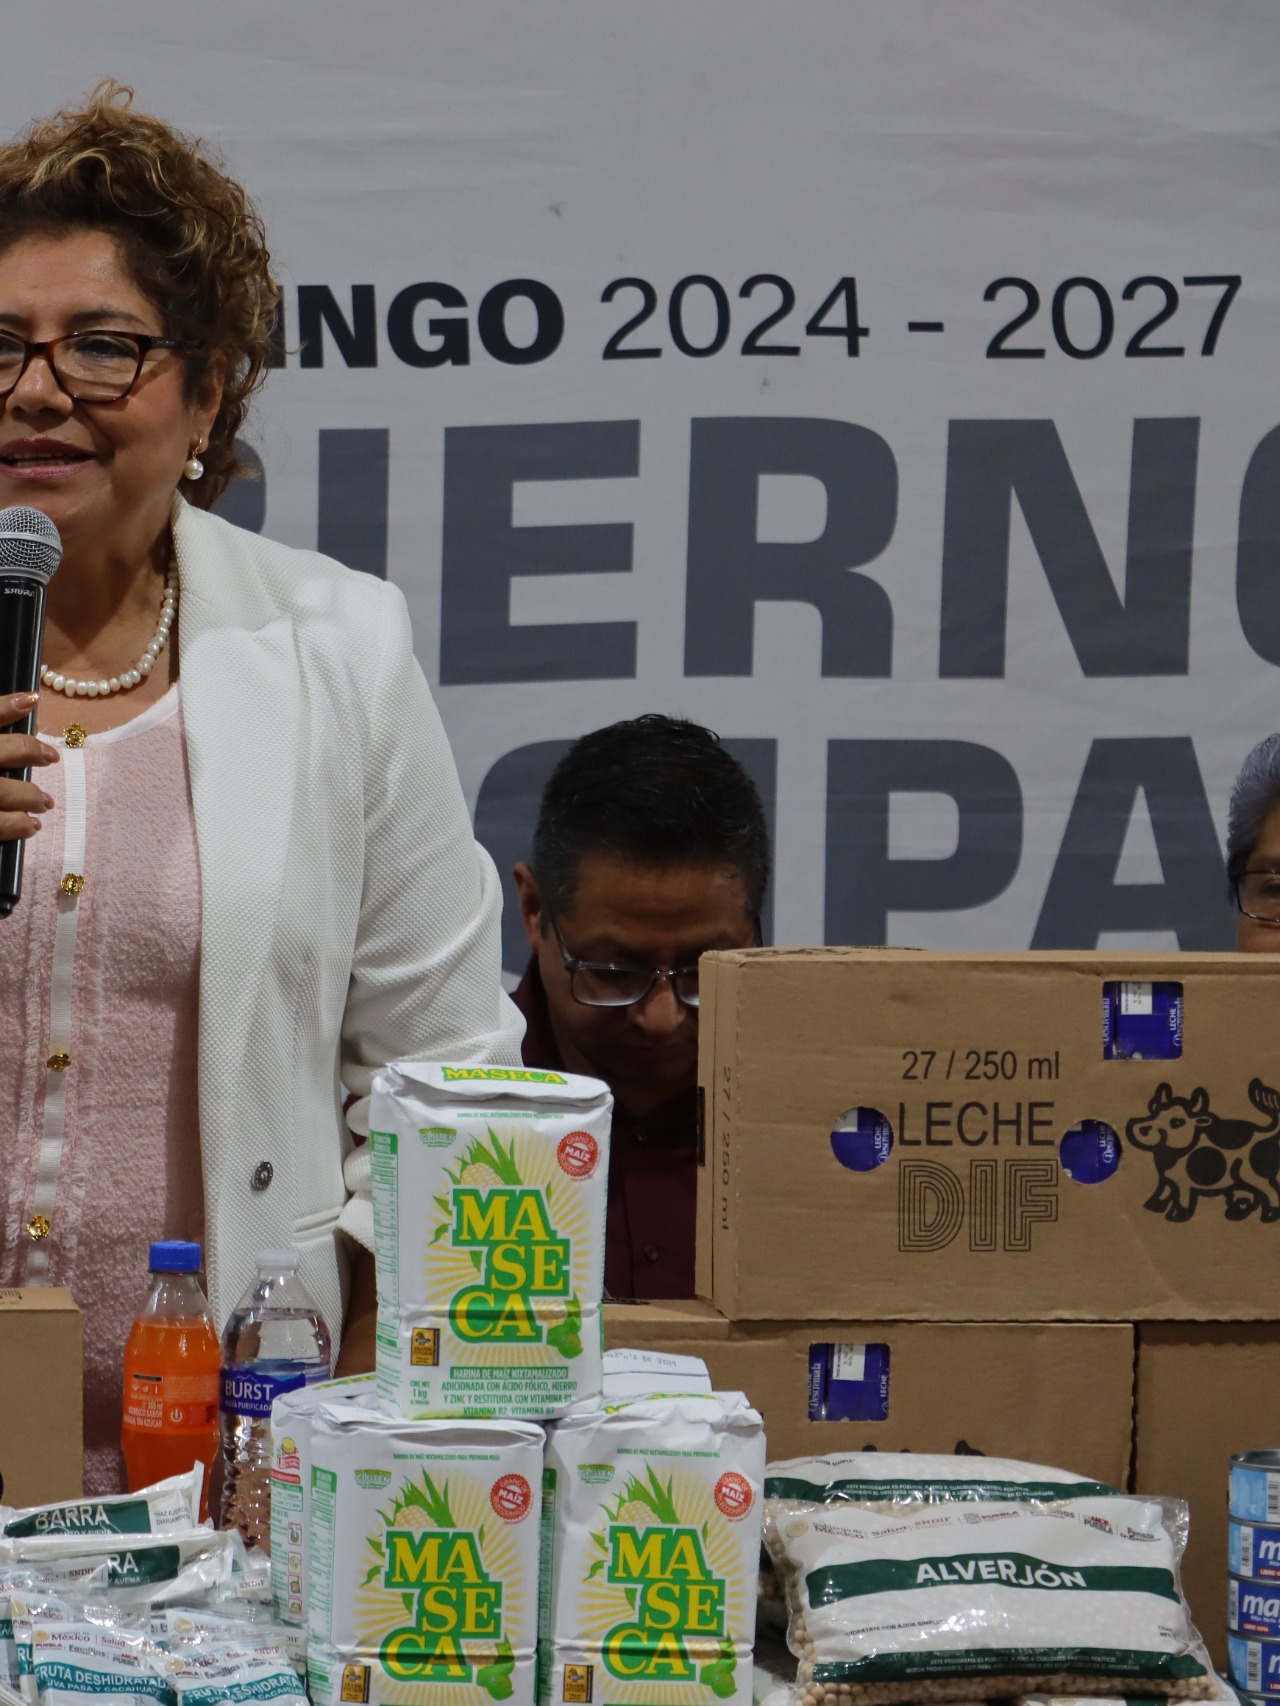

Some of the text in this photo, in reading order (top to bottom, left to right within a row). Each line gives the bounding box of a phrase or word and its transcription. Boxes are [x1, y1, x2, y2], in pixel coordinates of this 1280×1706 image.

[599, 273, 870, 361] 2024
[907, 318, 945, 334] -
[981, 274, 1242, 361] 2027
[1169, 1008, 1177, 1031] LECHE
[443, 1067, 567, 1084] MASECA
[901, 1050, 1060, 1081] 27 / 250 ml
[898, 1101, 1055, 1146] LECHE
[874, 1126, 882, 1149] LECHE
[565, 1145, 592, 1161] MAÍZ
[721, 1132, 732, 1186] 250
[460, 1194, 550, 1242] MA
[898, 1159, 1058, 1252] DIF
[490, 1244, 565, 1291] SE
[454, 1291, 536, 1338] CA
[453, 1366, 567, 1379] HARINA DE MAÍZ NIXTAMALIZADO
[225, 1381, 274, 1400] BURST
[441, 1379, 577, 1392] ADICIONADA CON ÁCIDO FÓLICO, HIERRO
[450, 1394, 466, 1403] ZINC
[474, 1394, 513, 1403] RESTITUIDA
[515, 1394, 528, 1403] CON
[530, 1394, 564, 1403] VITAMINA
[463, 1407, 497, 1415] VITAMINA
[511, 1407, 544, 1415] VITAMINA
[498, 1488, 524, 1505] MAÍZ
[722, 1486, 745, 1502] MAÍZ
[35, 1505, 111, 1530] BARRA
[871, 1511, 1019, 1537] Salud SNDIF PUEBLA
[1084, 1519, 1113, 1535] PUEBLA
[392, 1538, 483, 1582] MA
[614, 1533, 705, 1579] MA
[239, 1580, 266, 1589] SNDIF
[916, 1558, 1087, 1589] ALVERJÓN
[422, 1586, 497, 1632] SE
[646, 1583, 720, 1630] SE
[51, 1632, 126, 1647] México Salud
[386, 1634, 466, 1677] CA
[608, 1630, 686, 1676] CA
[35, 1666, 72, 1681] FRUTA
[47, 1679, 65, 1689] UVA
[68, 1683, 93, 1692] PASA
